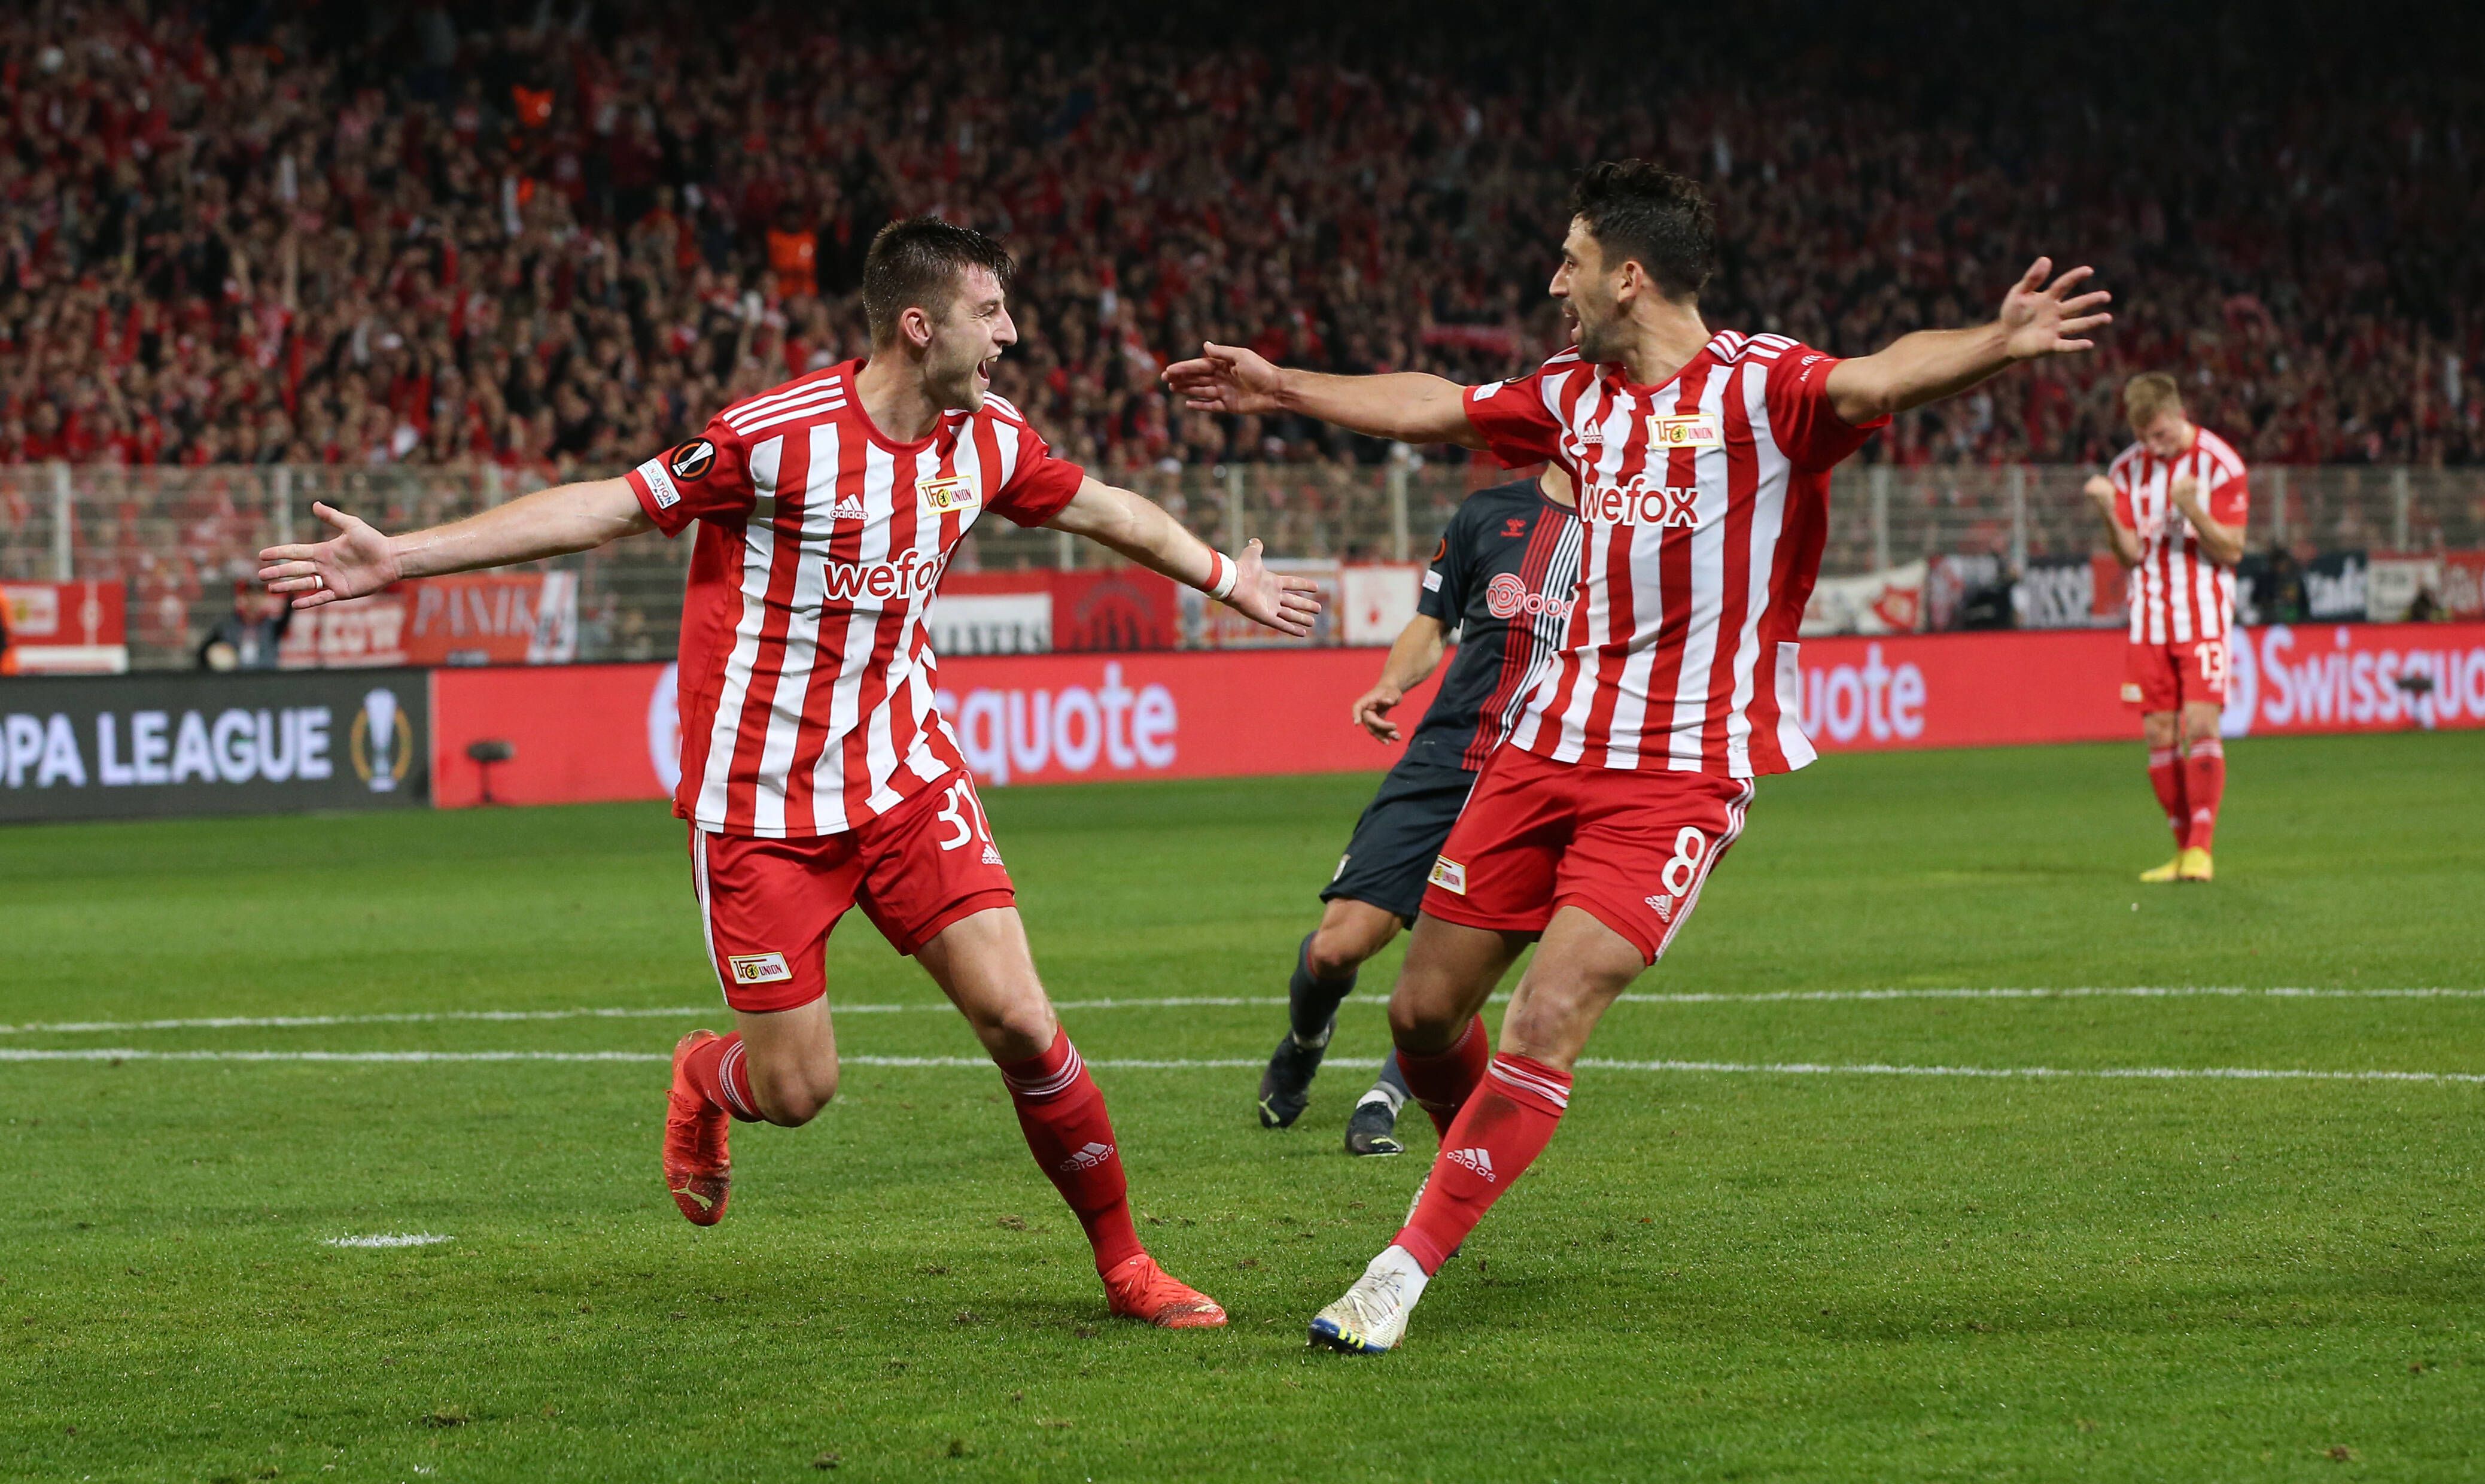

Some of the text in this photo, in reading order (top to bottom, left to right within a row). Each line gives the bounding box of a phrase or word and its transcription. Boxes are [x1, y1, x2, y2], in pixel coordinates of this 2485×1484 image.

[950, 488, 972, 503] UNION
[1580, 473, 1702, 528] wefox
[830, 509, 869, 521] adidas
[2194, 641, 2226, 682] 13
[0, 705, 333, 788] PA LEAGUE
[936, 779, 990, 851] 31
[1661, 826, 1706, 898] 8
[758, 964, 783, 976] UNION
[1060, 1144, 1114, 1173] adidas
[1446, 1151, 1497, 1183] adidas
